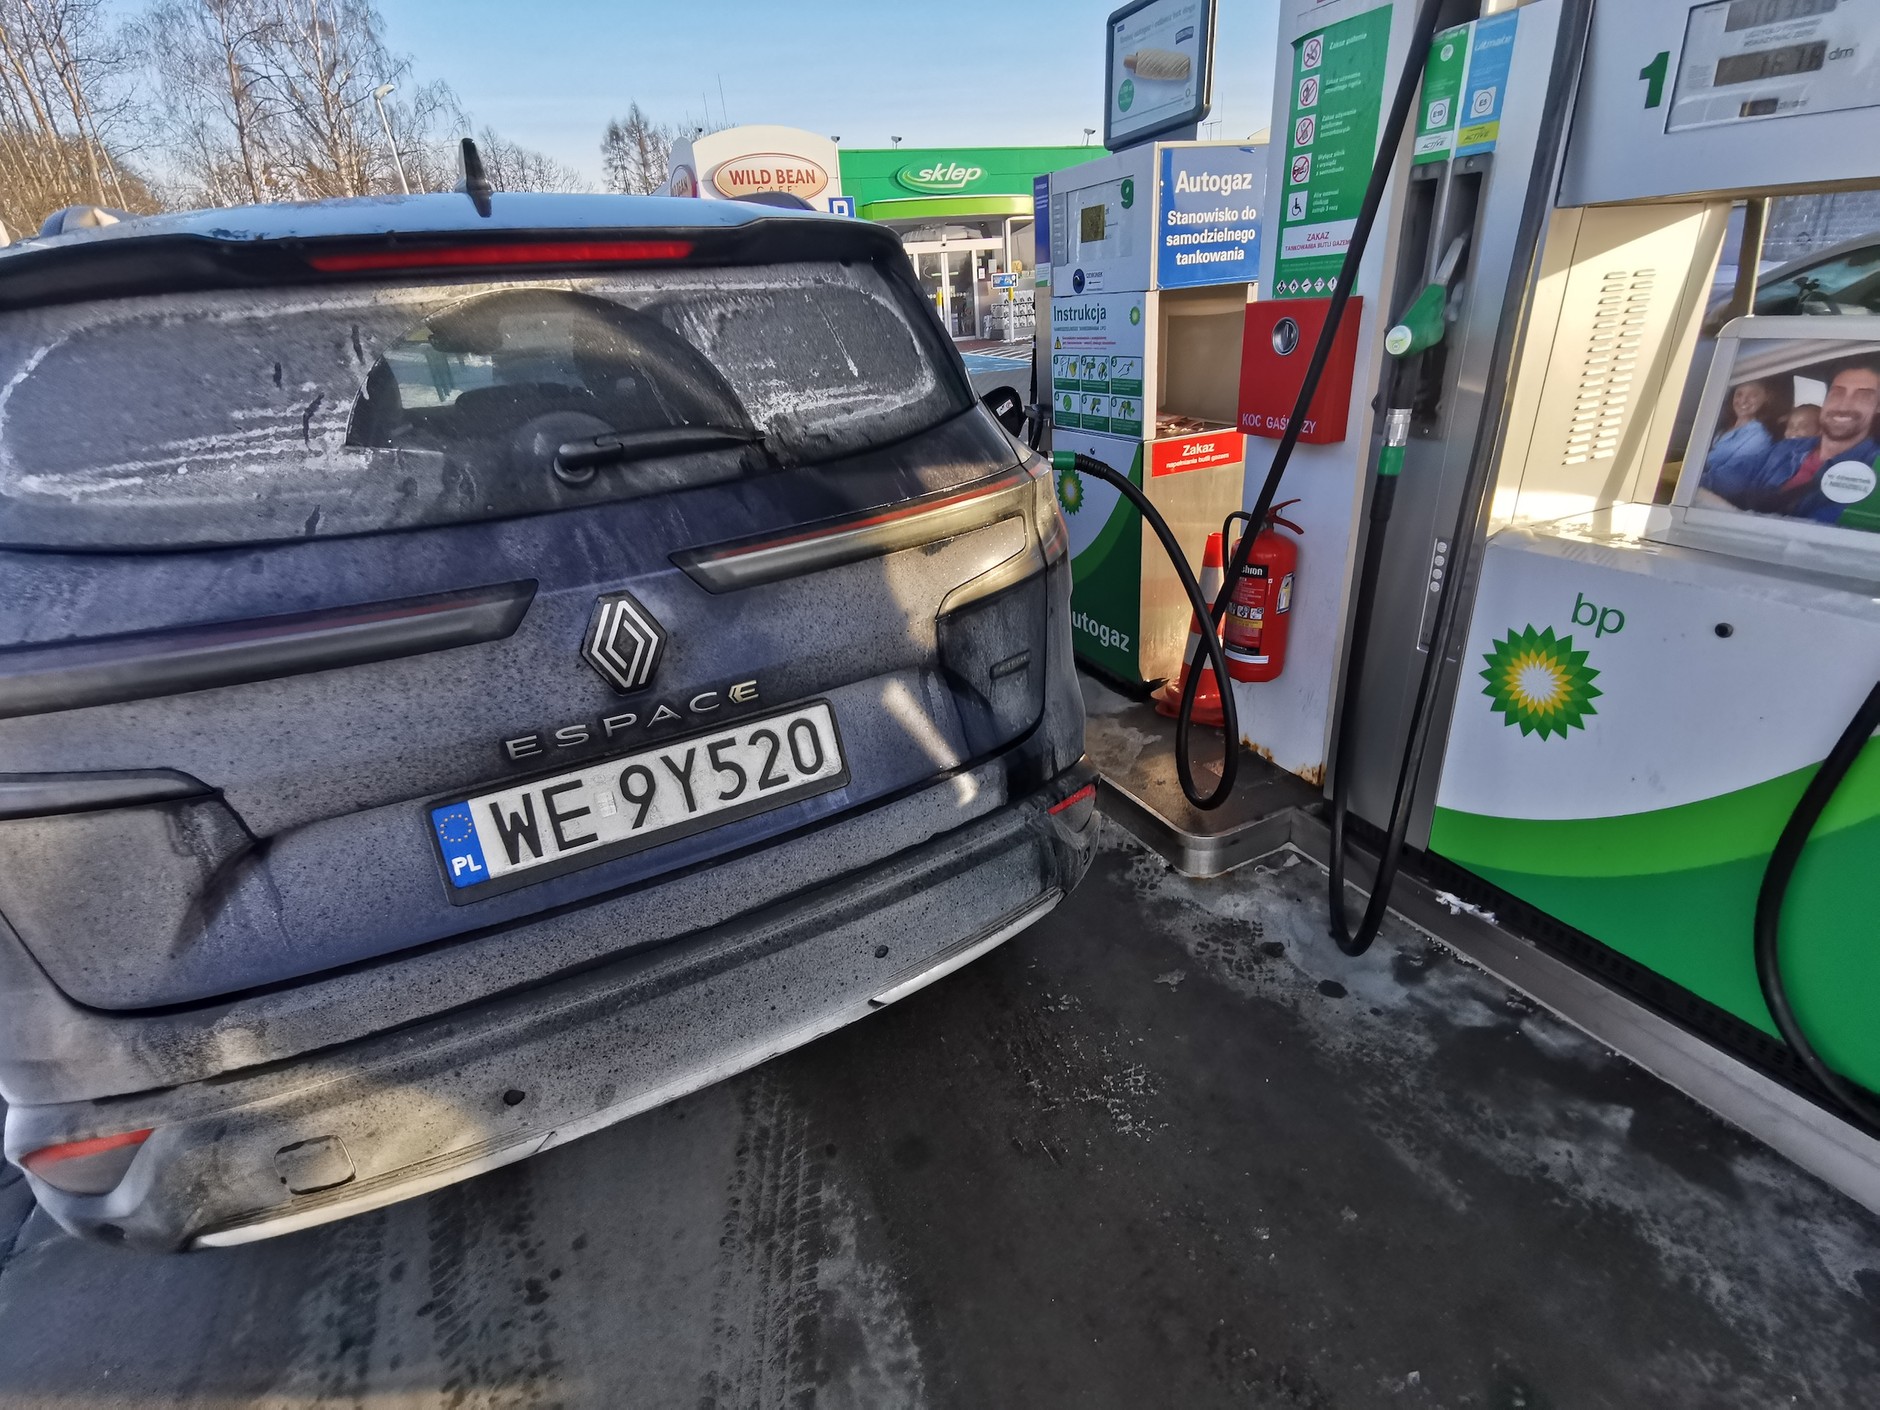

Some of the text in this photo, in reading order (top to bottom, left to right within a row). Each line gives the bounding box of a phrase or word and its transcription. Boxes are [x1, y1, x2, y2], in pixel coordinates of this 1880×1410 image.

[1638, 51, 1670, 109] 1
[1478, 98, 1488, 107] E5
[1432, 109, 1443, 118] E10
[728, 169, 816, 185] WILD BEAN
[919, 162, 982, 188] sklep
[1175, 170, 1252, 196] Autogaz
[1120, 178, 1134, 209] 9
[1167, 206, 1257, 226] Stanowisko do
[1166, 227, 1256, 247] samodzielnego
[1306, 231, 1330, 242] ZAKAZ
[1175, 247, 1245, 266] tankowania
[1053, 303, 1107, 324] Instrukcja
[1242, 413, 1317, 434] KOC GAŚZY
[1182, 442, 1215, 457] Zakaz
[1571, 592, 1625, 638] bp
[1072, 610, 1130, 653] utogaz
[505, 680, 760, 760] ESPACE
[489, 718, 826, 866] WE 9Y520
[451, 854, 482, 877] PL
